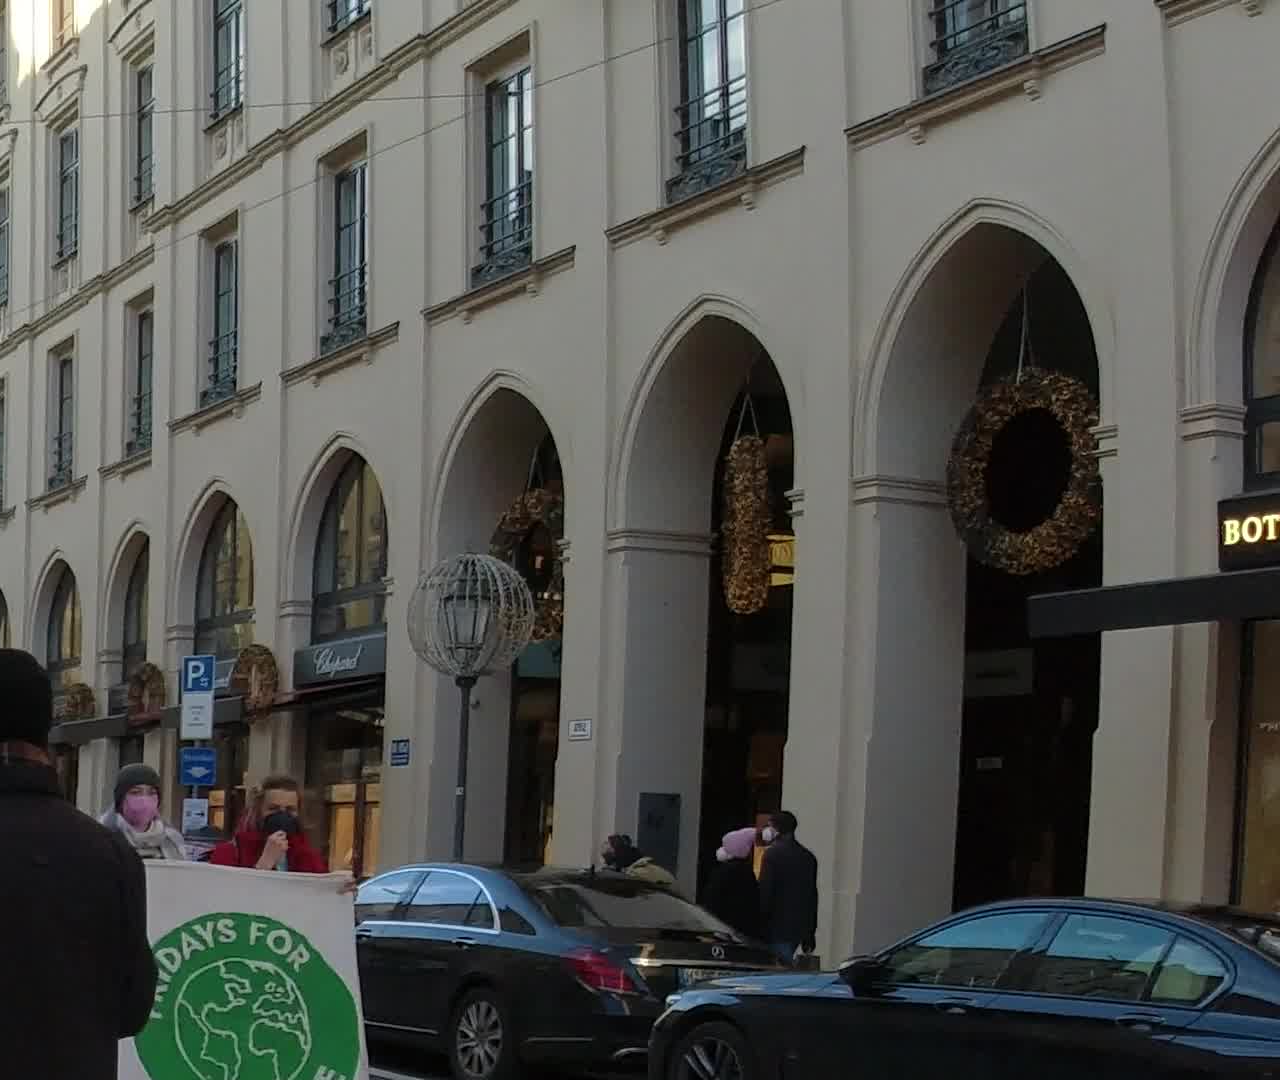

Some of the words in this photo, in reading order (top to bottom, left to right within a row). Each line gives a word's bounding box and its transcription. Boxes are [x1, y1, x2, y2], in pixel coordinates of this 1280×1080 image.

[1223, 514, 1280, 546] BOT
[187, 660, 205, 689] P
[249, 921, 311, 973] FOR
